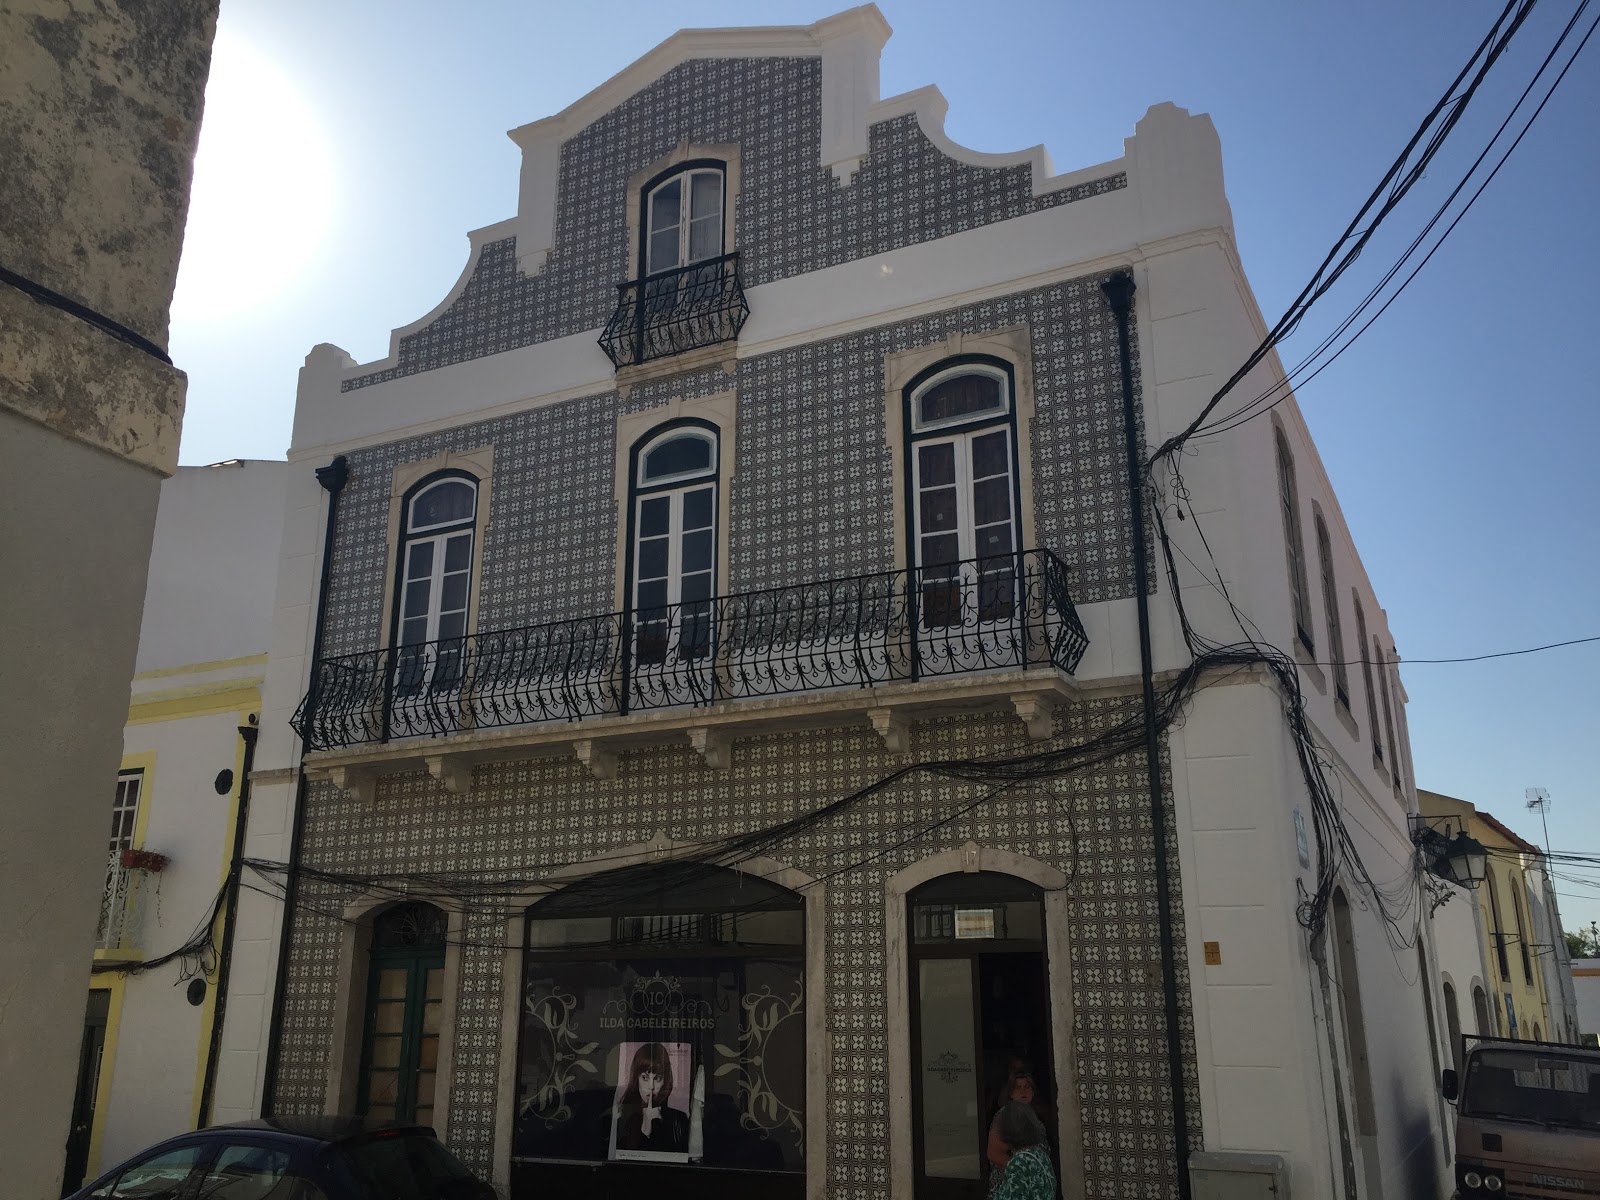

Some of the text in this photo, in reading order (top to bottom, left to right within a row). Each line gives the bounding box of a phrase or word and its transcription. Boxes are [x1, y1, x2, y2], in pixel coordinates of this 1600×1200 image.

[654, 844, 664, 857] 15
[965, 850, 977, 865] 17
[649, 991, 664, 1005] IC
[599, 1017, 715, 1029] ILDA CABELEIREIROS
[1532, 1173, 1585, 1190] NISSAN
